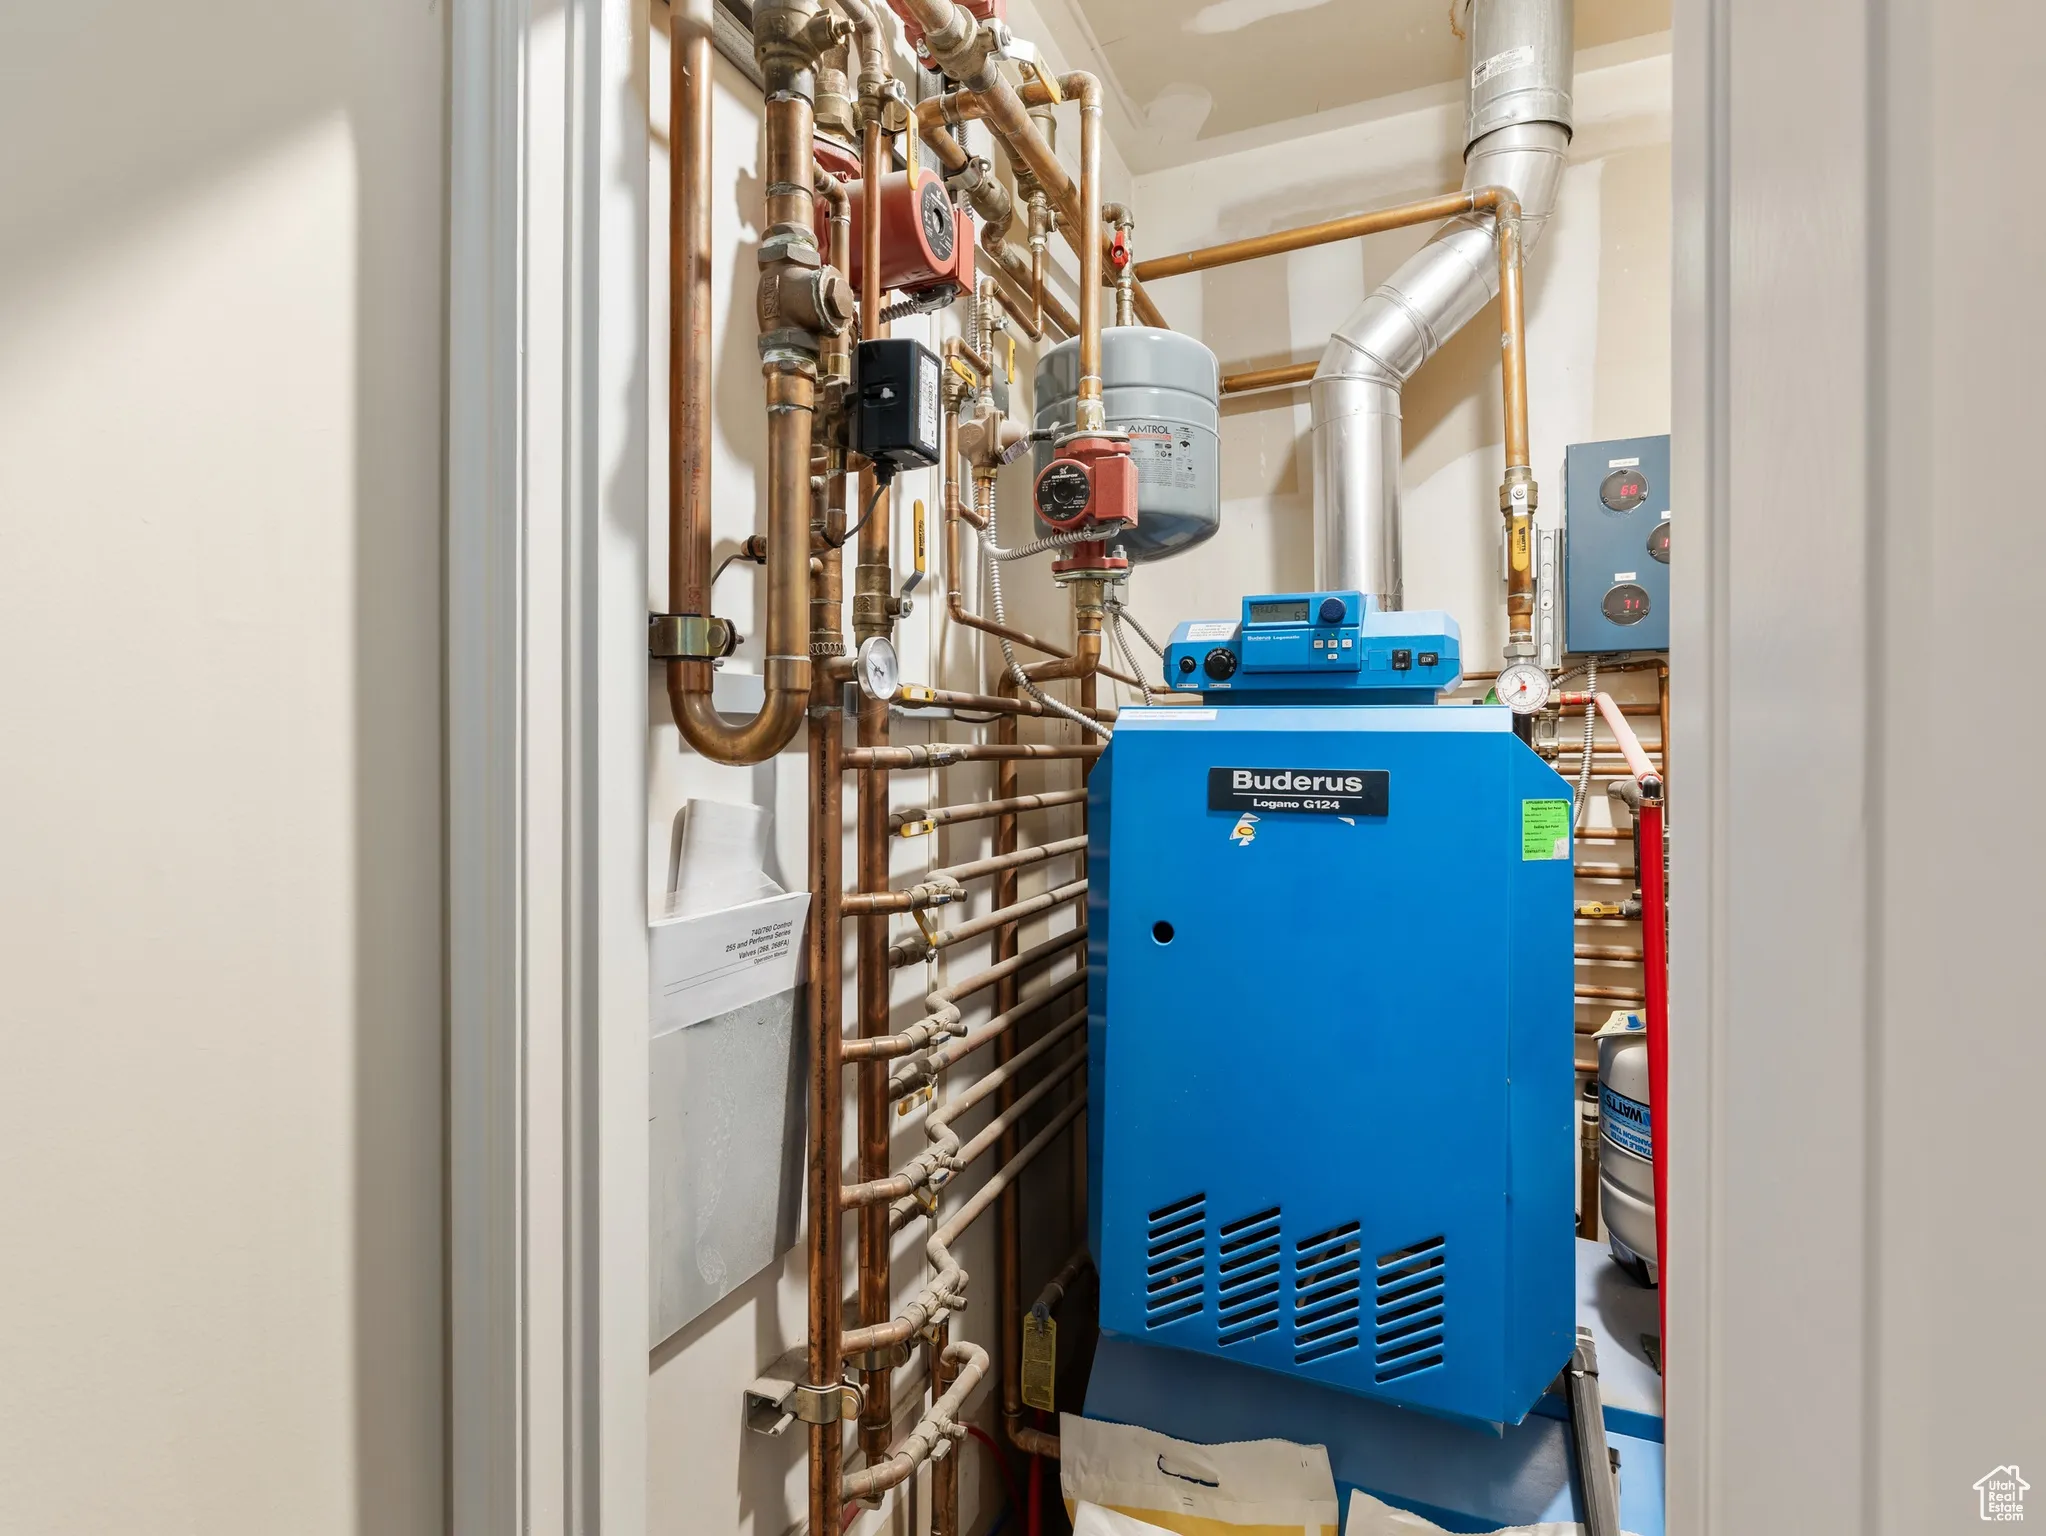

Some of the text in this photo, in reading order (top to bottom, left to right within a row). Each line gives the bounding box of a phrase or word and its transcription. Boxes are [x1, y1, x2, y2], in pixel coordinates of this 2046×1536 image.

[1128, 425, 1171, 434] AMTROL
[1621, 484, 1638, 496] 68
[1624, 599, 1640, 609] 71
[1294, 611, 1308, 621] 63
[1233, 770, 1363, 792] Buderus
[1253, 798, 1340, 810] Logano G124
[772, 920, 793, 931] Control
[725, 929, 792, 953] 255 and Performa Series
[738, 949, 757, 960] Valves
[1606, 1094, 1643, 1124] WATTS
[1622, 1130, 1653, 1148] PANSION
[1628, 1140, 1653, 1157] TABLE
